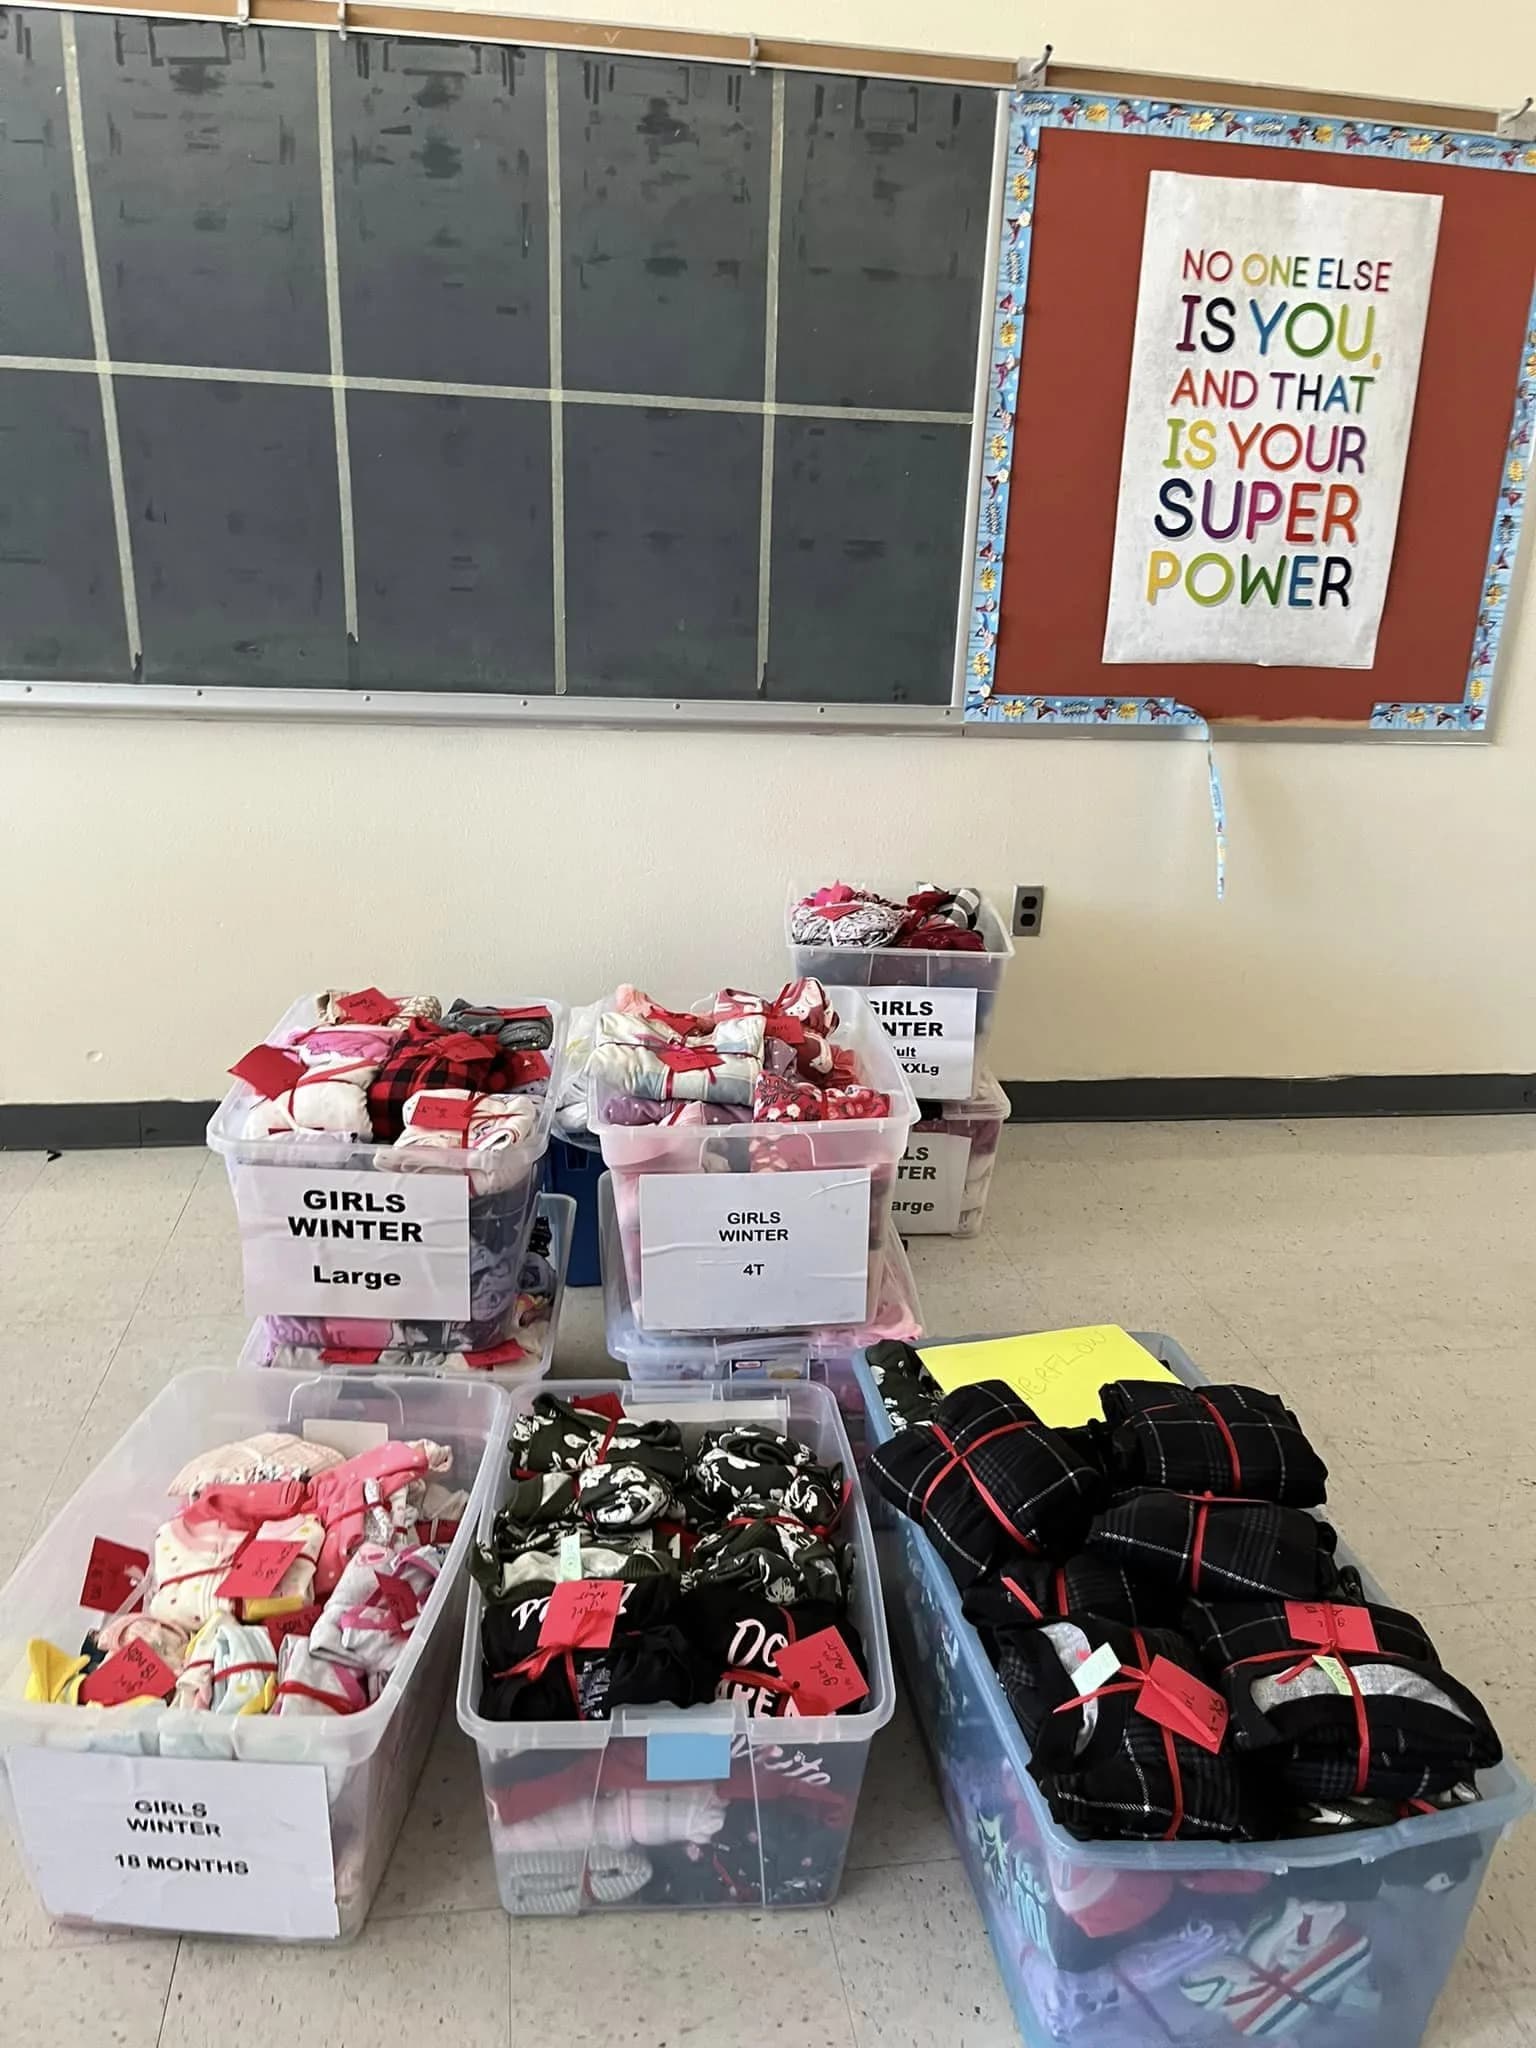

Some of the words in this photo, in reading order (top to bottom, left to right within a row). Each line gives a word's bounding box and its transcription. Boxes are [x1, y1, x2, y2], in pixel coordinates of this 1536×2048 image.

[1182, 248, 1233, 282] NO
[1242, 252, 1310, 288] ONE
[1317, 256, 1392, 292] ELSE
[1176, 294, 1237, 354] IS
[1170, 367, 1259, 410] AND
[1269, 371, 1375, 413] THAT
[1162, 418, 1217, 470] IS
[1228, 421, 1367, 474] YOUR
[1154, 477, 1360, 544] SUPER
[1146, 550, 1352, 608] POWER
[881, 1021, 944, 1037] NTER
[893, 1046, 917, 1057] ult
[897, 1165, 937, 1180] TER
[303, 1189, 406, 1213] GIRLS
[891, 1200, 935, 1215] arge
[287, 1215, 424, 1243] WINTER
[727, 1211, 782, 1225] GIRLS
[718, 1228, 789, 1242] WINTER
[313, 1264, 402, 1291] Large
[743, 1263, 765, 1276] 4T
[134, 1799, 208, 1819] GIRLS
[126, 1817, 222, 1838] WINTER
[115, 1852, 142, 1870] 18
[147, 1855, 249, 1876] MONTHS
